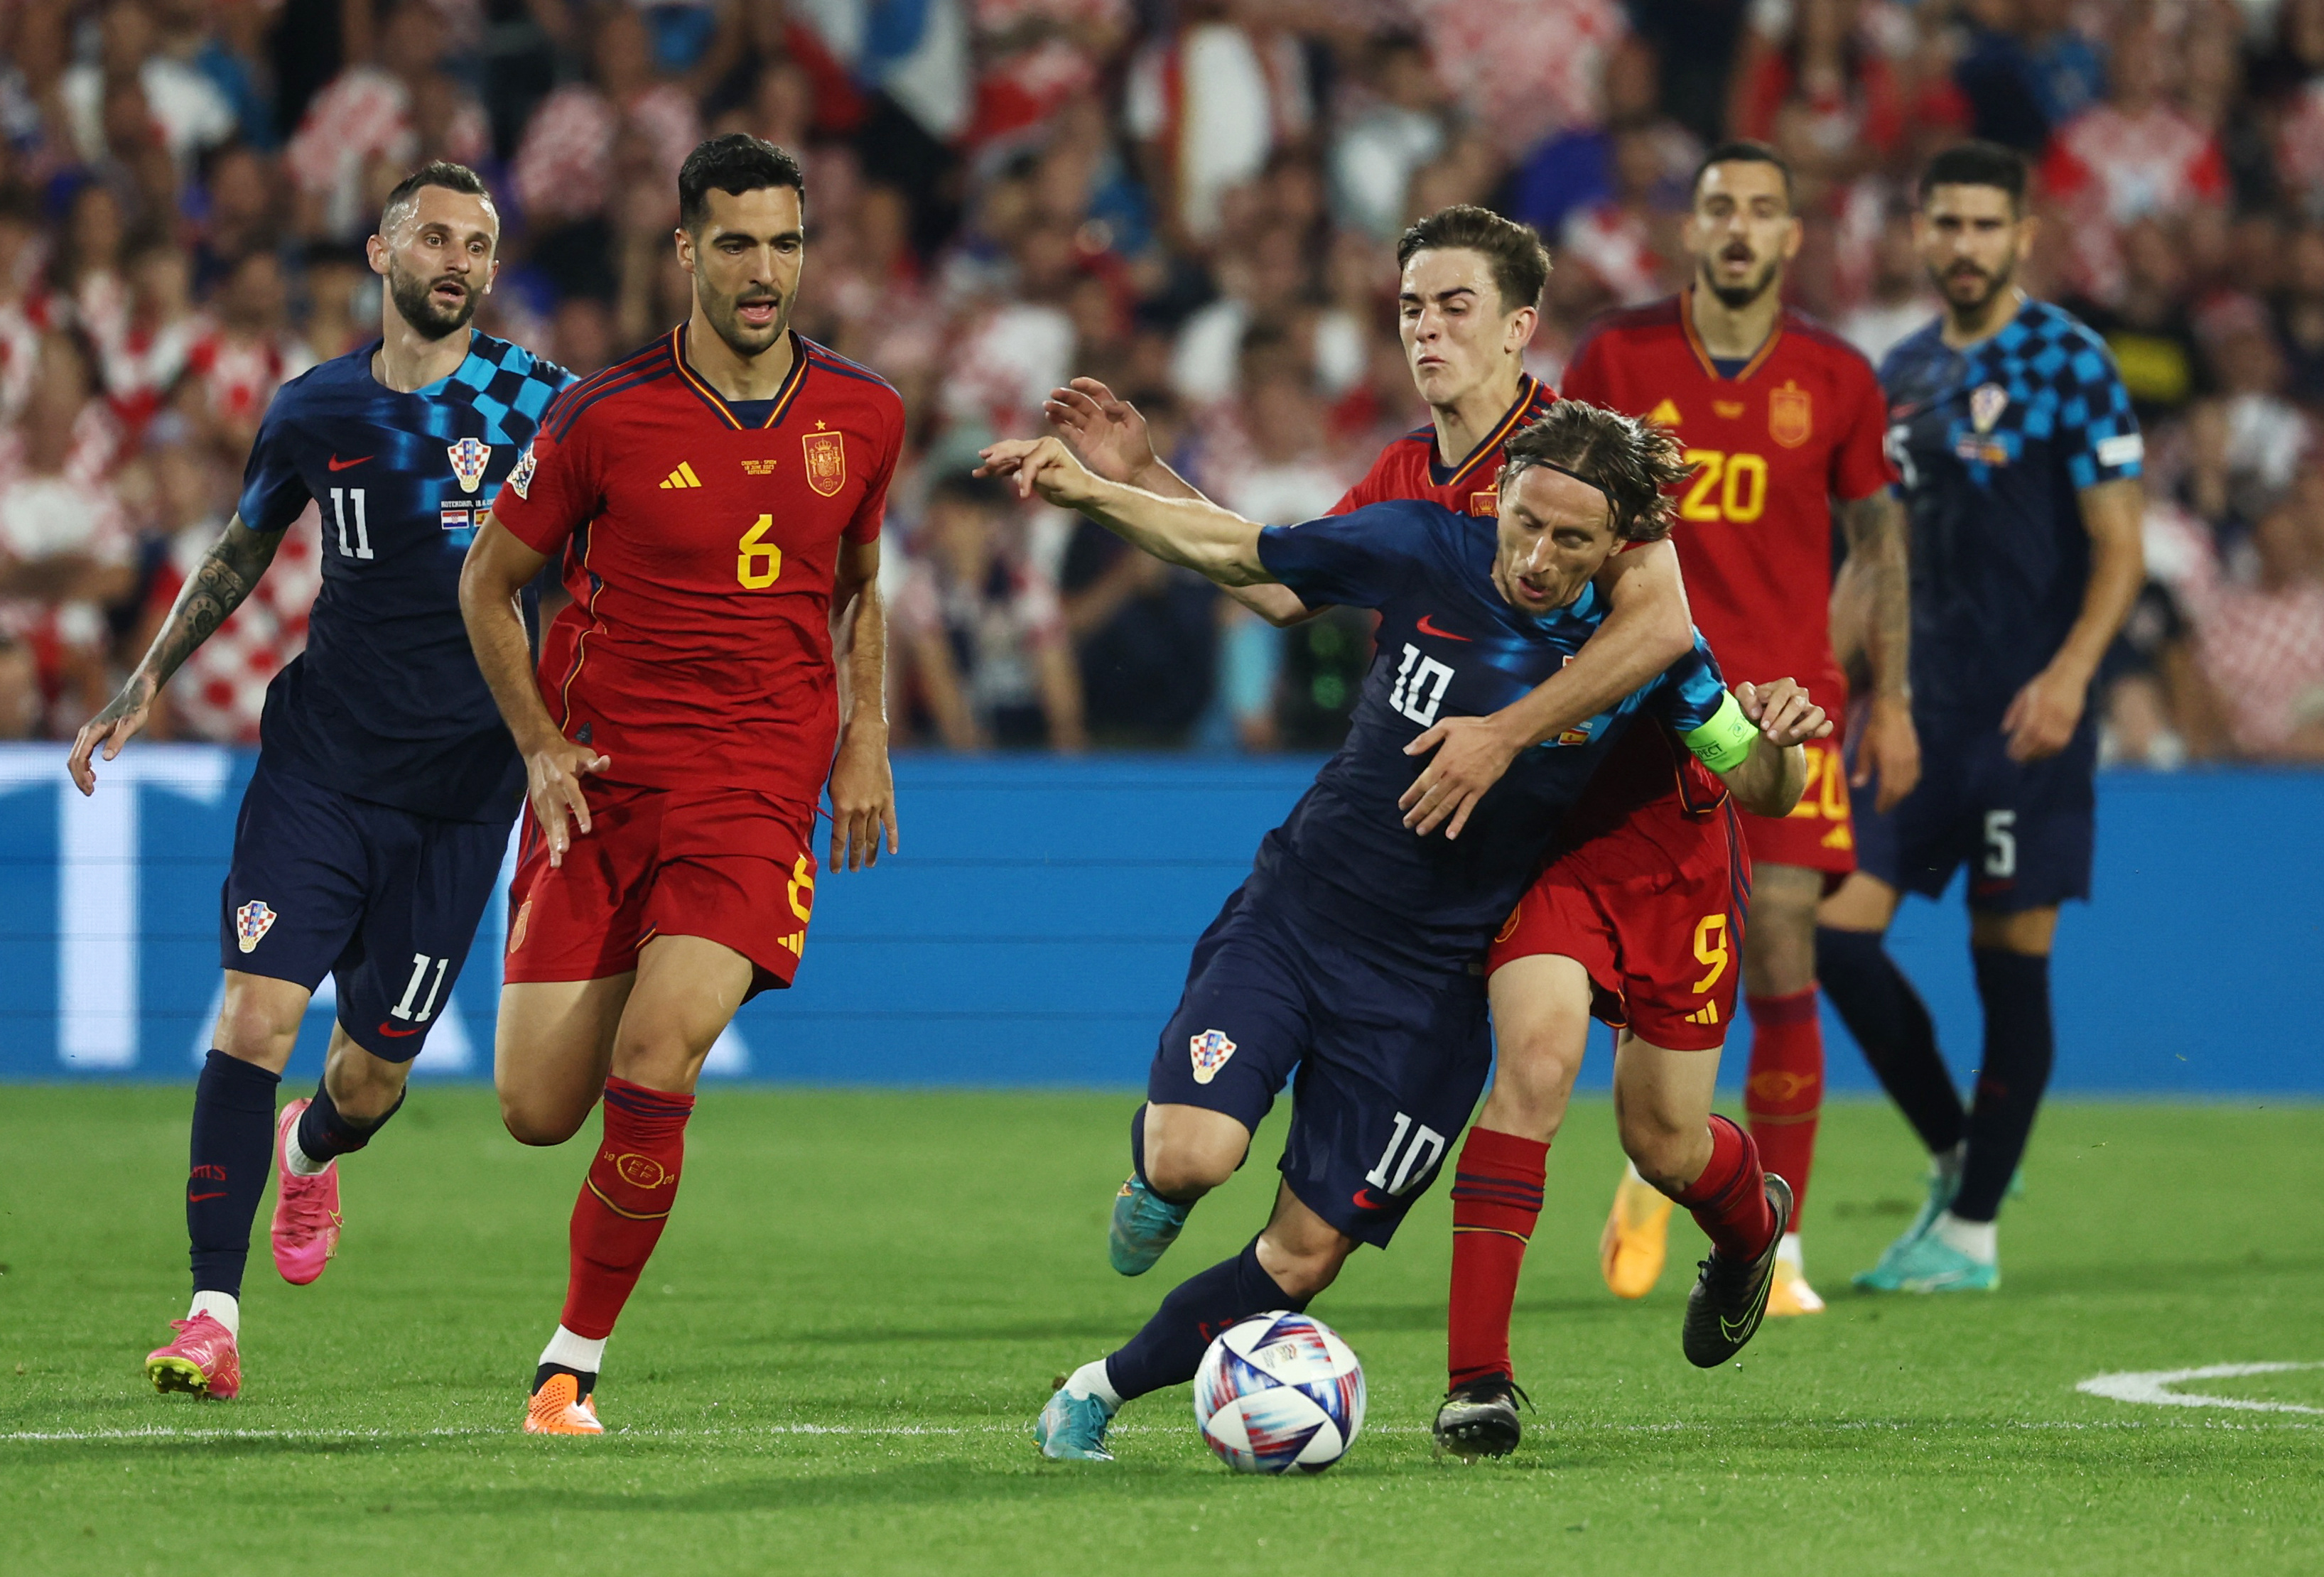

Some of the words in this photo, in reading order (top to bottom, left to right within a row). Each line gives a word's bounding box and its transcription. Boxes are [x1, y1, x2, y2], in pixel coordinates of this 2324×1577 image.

[330, 487, 374, 560] 11
[1680, 449, 1767, 523] 20
[737, 514, 782, 590] 6
[1389, 643, 1454, 728] 10
[1983, 809, 2016, 878] 5
[390, 953, 449, 1022] 11
[1692, 914, 1729, 994] 9
[1366, 1110, 1445, 1197] 10
